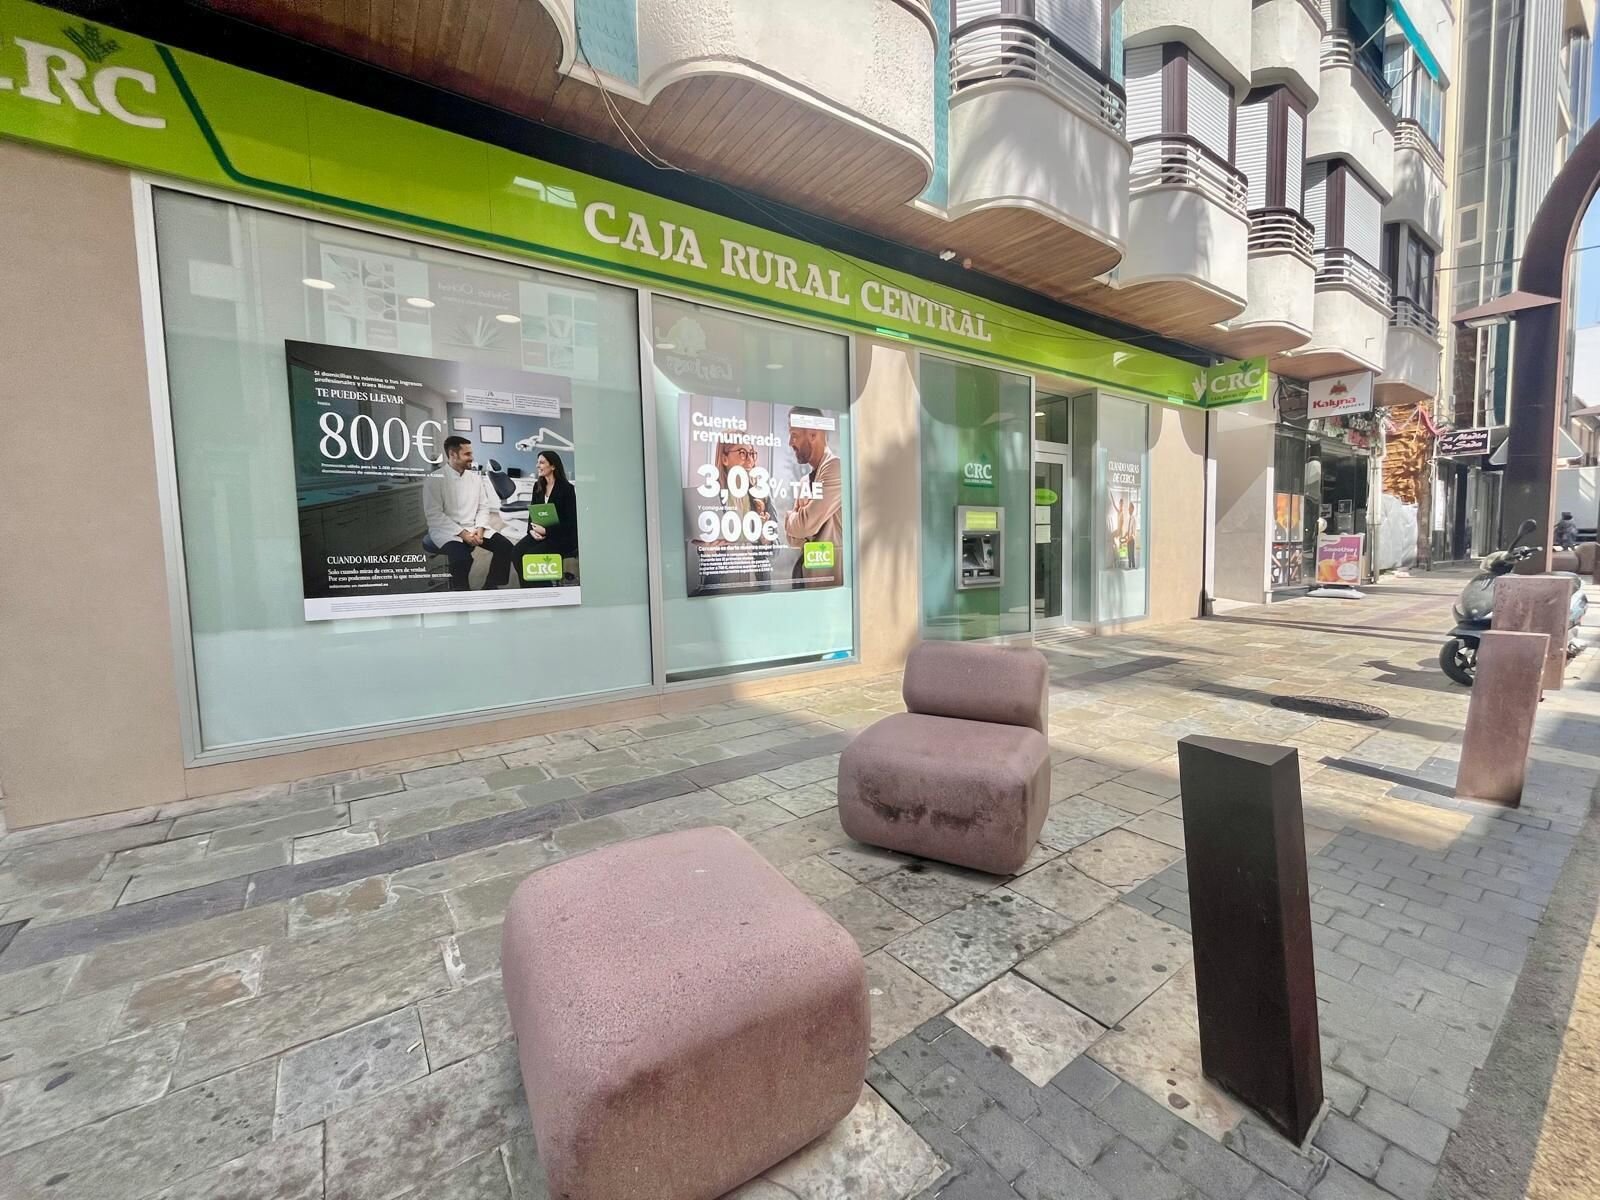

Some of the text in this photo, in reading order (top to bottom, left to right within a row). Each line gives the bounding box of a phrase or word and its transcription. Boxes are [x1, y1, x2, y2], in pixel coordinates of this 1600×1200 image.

[0, 36, 167, 129] RC
[584, 202, 992, 342] CAJA RURAL CENTRAL
[1210, 368, 1263, 393] CRC
[315, 387, 404, 405] TE PUEDES LLEVAR
[692, 412, 748, 431] Cuenta
[693, 428, 782, 447] remunerada
[964, 462, 993, 480] CRC
[697, 510, 779, 543] 900€
[327, 554, 427, 565] CUANDO MIRAS DE CERCA
[806, 550, 831, 562] CRC
[526, 562, 559, 575] CRC
[348, 574, 371, 582] podemos
